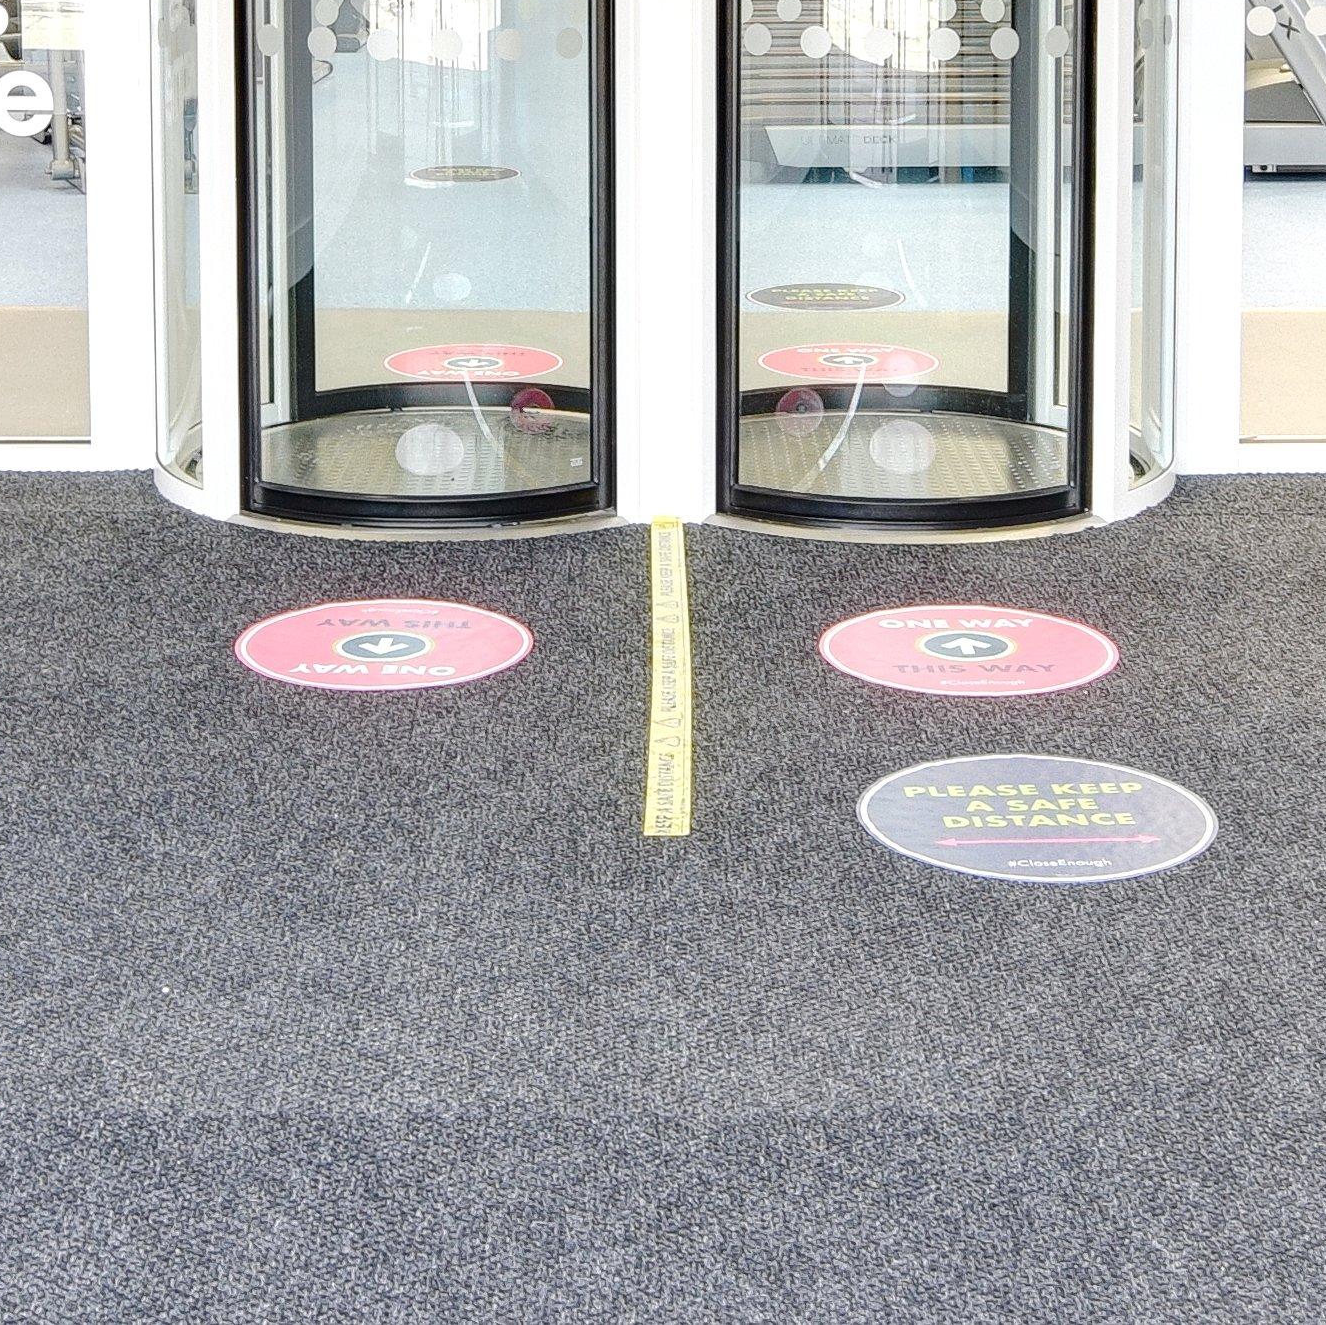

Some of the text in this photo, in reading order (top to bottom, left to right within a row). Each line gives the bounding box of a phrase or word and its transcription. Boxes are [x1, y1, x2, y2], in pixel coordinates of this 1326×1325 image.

[317, 619, 471, 629] THIS WAY
[878, 618, 1034, 629] ONE WAY
[289, 661, 456, 676] ONE WAY
[892, 663, 1056, 674] THIS WAY
[903, 781, 1144, 799] PLEASE KEEP
[966, 797, 1099, 812] A SAFE
[941, 812, 1137, 830] DISTANCE
[1007, 857, 1113, 869] #CloseEnough
